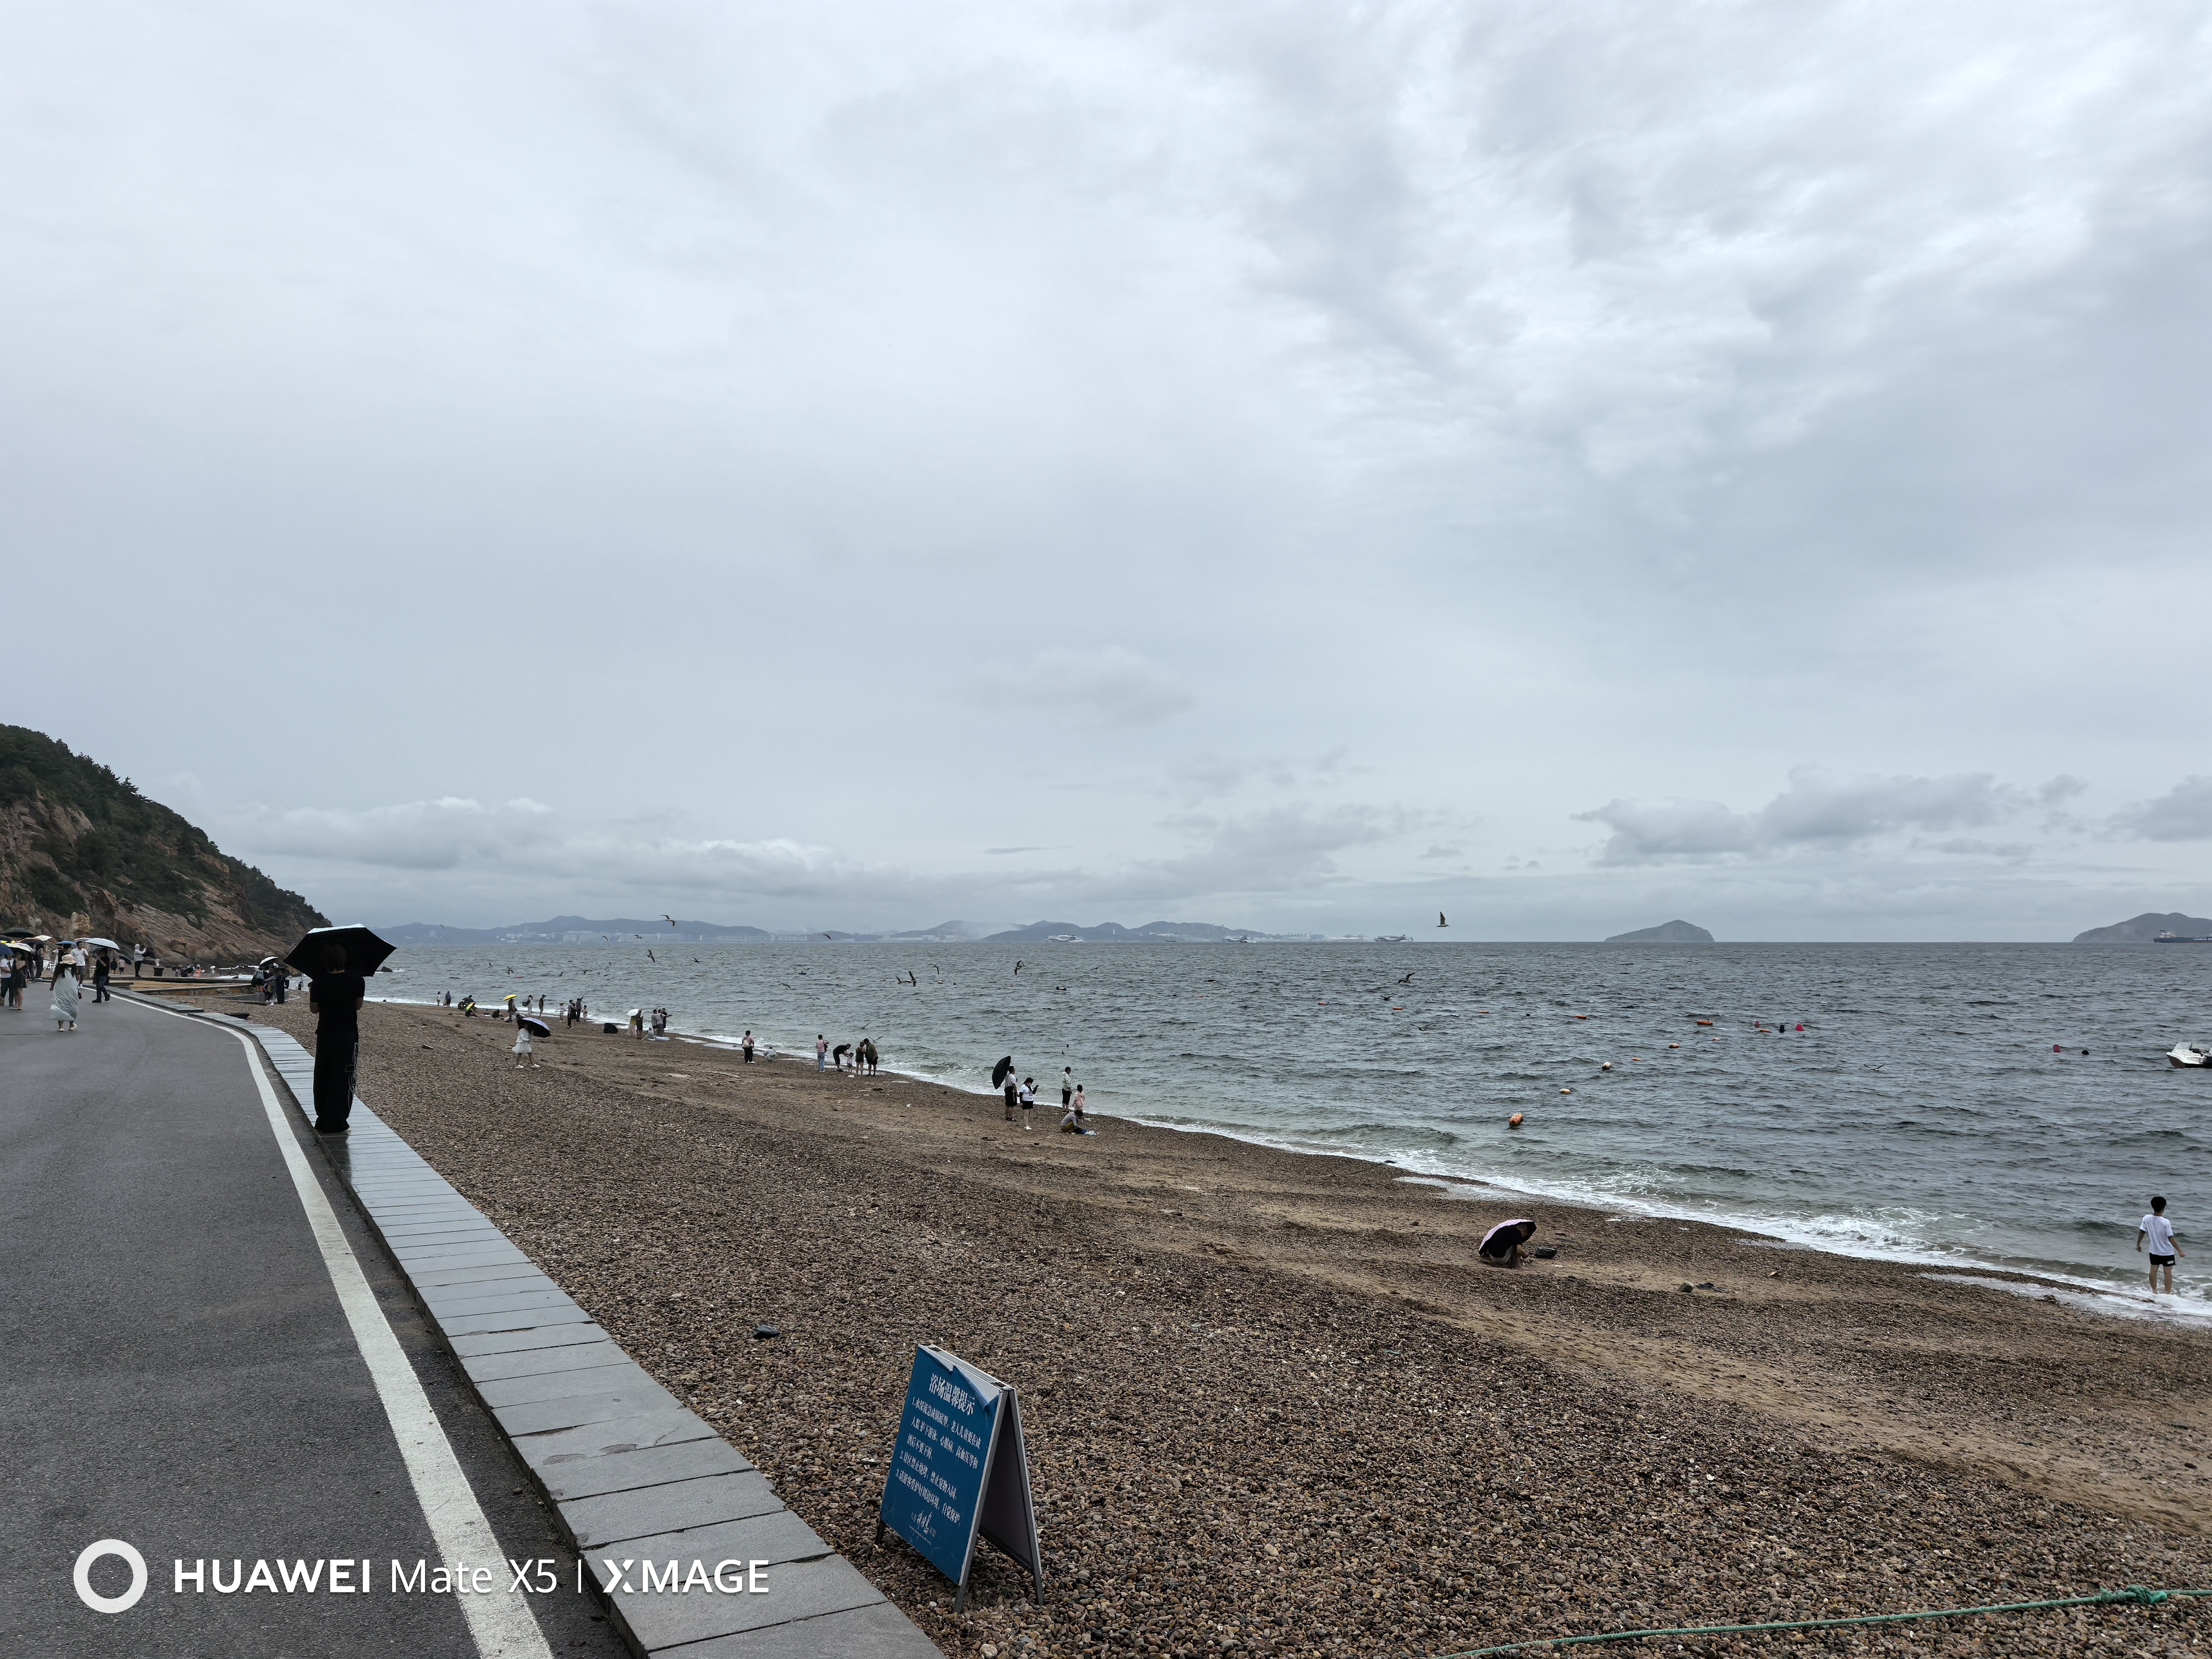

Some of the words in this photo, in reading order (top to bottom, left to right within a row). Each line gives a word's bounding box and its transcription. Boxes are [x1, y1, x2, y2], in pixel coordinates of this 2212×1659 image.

[929, 1372, 975, 1416] 浴场温馨提示
